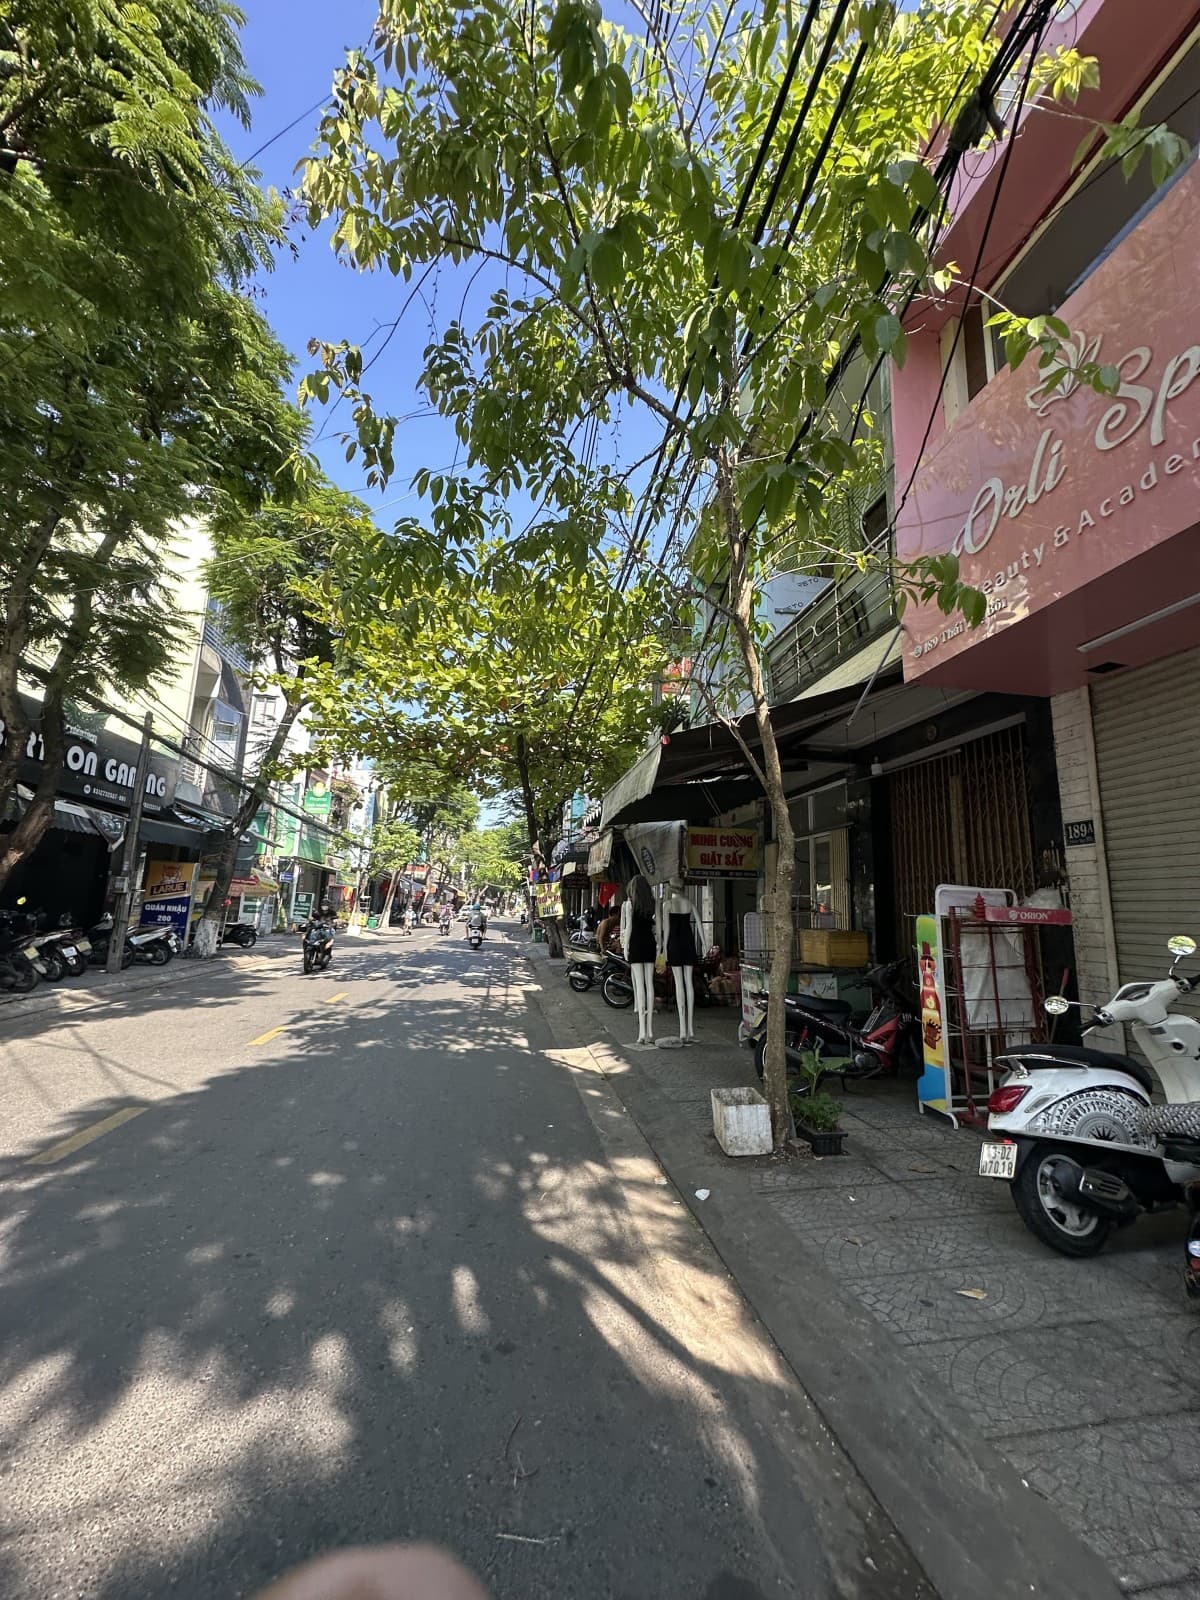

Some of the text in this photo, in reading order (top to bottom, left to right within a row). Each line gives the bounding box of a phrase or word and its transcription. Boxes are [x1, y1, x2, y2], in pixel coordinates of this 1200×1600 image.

[949, 428, 1068, 557] Orli
[982, 541, 1045, 596] eauty
[1053, 525, 1072, 548] &
[1067, 823, 1094, 839] 189A
[700, 847, 745, 868] GIẶT SẤY
[152, 882, 186, 895] LARUE
[144, 903, 166, 912] QUÁN
[1020, 911, 1048, 920] ORION
